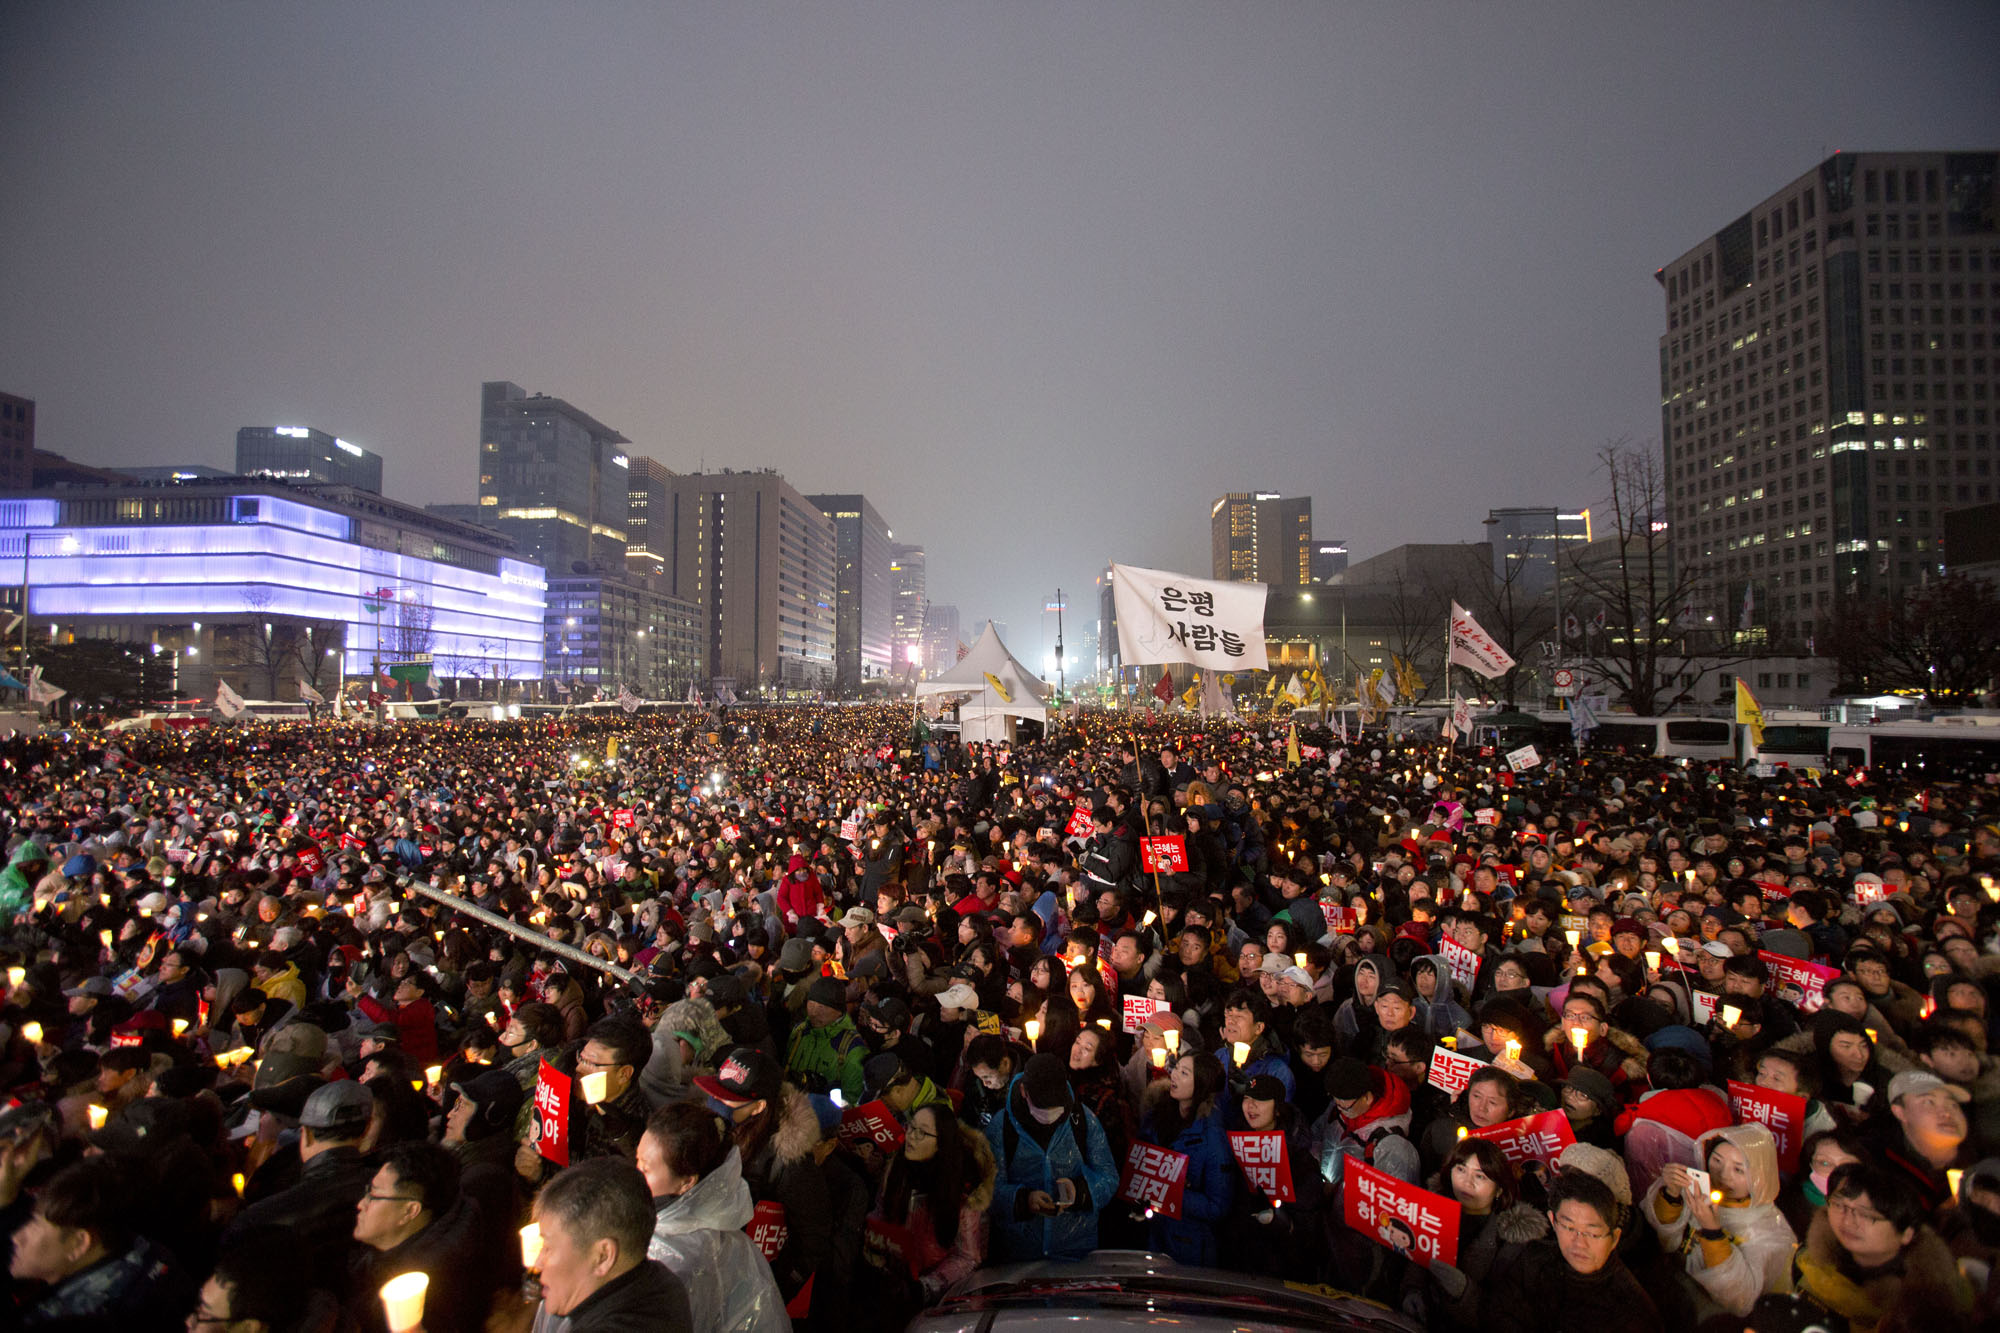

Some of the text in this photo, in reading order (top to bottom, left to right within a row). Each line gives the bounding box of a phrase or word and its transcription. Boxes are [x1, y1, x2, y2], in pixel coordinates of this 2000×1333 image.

[1160, 586, 1215, 617] 은평
[1167, 621, 1247, 657] 사람들
[1172, 855, 1182, 865] 야
[1765, 961, 1825, 990] 박근혜는
[1733, 1096, 1790, 1129] 박근혜는
[544, 1118, 560, 1145] 야
[874, 1128, 894, 1143] 야
[1127, 1143, 1187, 1183] 박근혜
[1231, 1135, 1282, 1164] 박근혜
[1125, 1173, 1170, 1209] 퇴진
[1358, 1176, 1444, 1235] 박근혜는
[1357, 1201, 1442, 1260] 하 야
